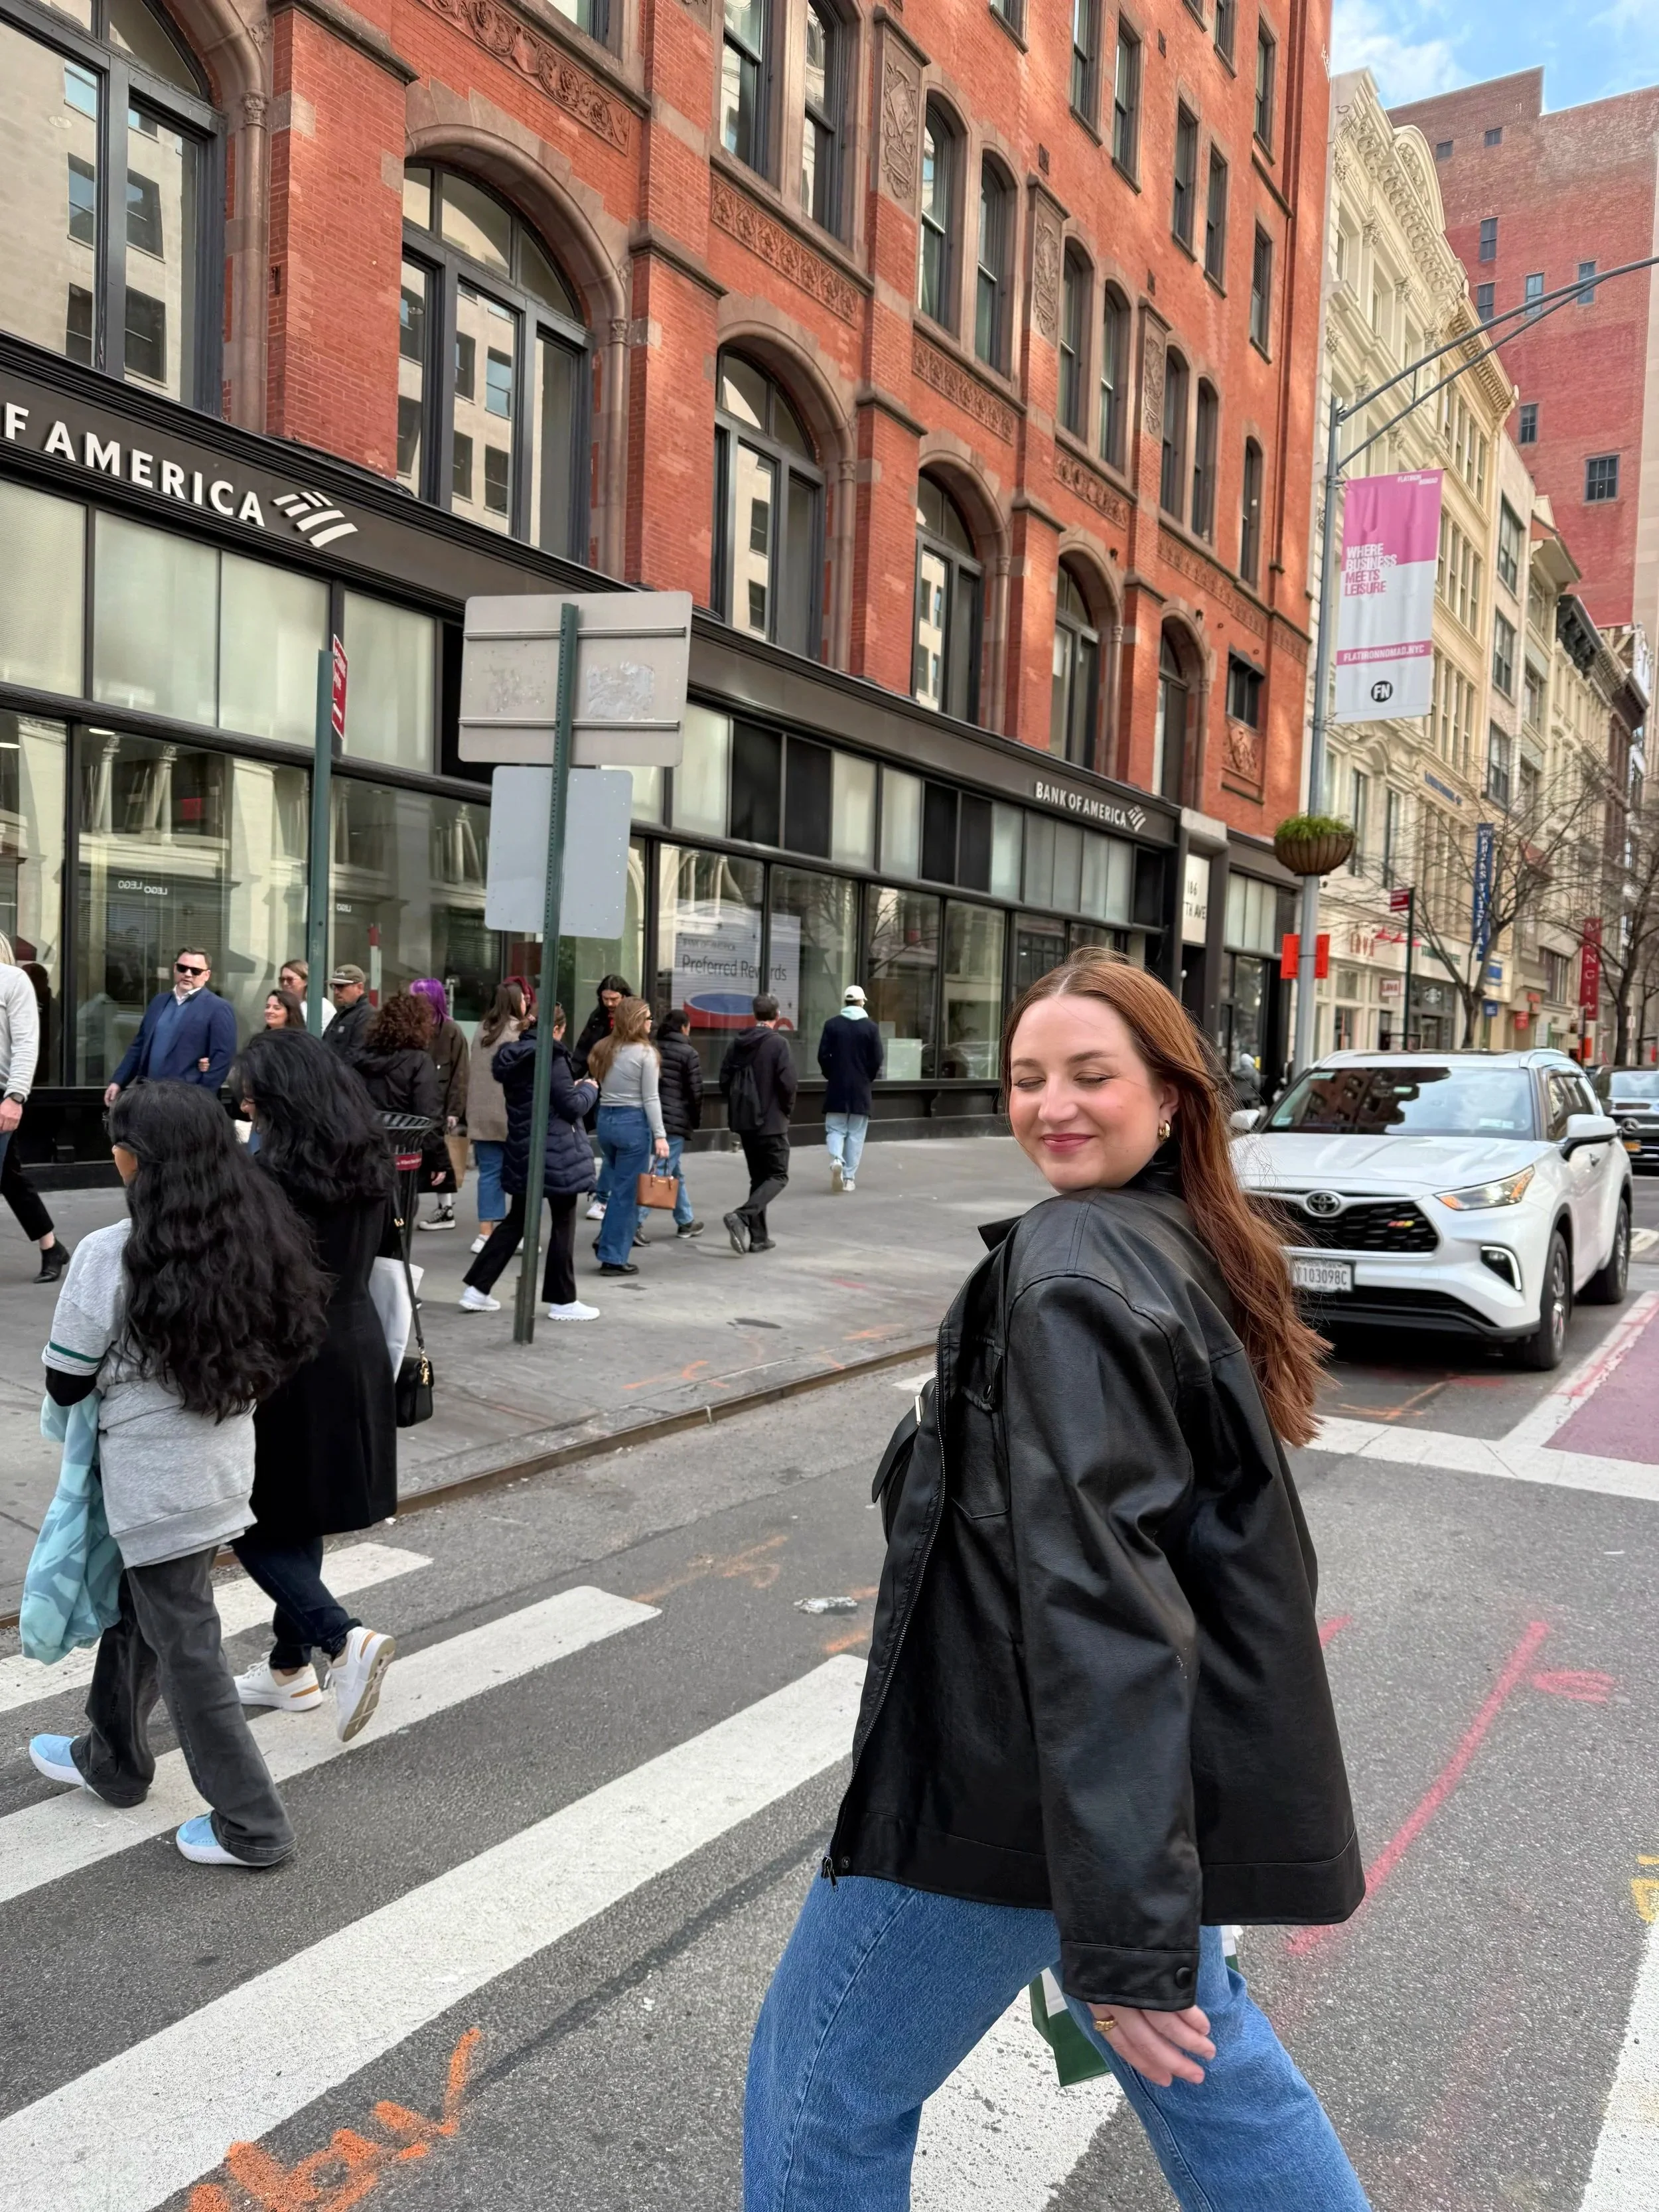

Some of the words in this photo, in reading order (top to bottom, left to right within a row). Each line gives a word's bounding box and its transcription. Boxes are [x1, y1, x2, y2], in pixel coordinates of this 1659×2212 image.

[4, 402, 29, 440] F
[43, 420, 265, 527] AMERICA
[1346, 543, 1384, 559] WHERE
[1345, 553, 1398, 571] BUSINESS
[1345, 569, 1380, 583] MEETS
[1344, 581, 1387, 596] LEISURE
[1343, 644, 1425, 662] FLATIRONNOMAD.NYC
[1374, 684, 1391, 700] FN
[1036, 781, 1066, 808] BANK
[1068, 793, 1084, 811] OF
[1082, 798, 1127, 828] AMERICA
[682, 954, 737, 977] Preferred
[741, 960, 787, 981] Rewrds
